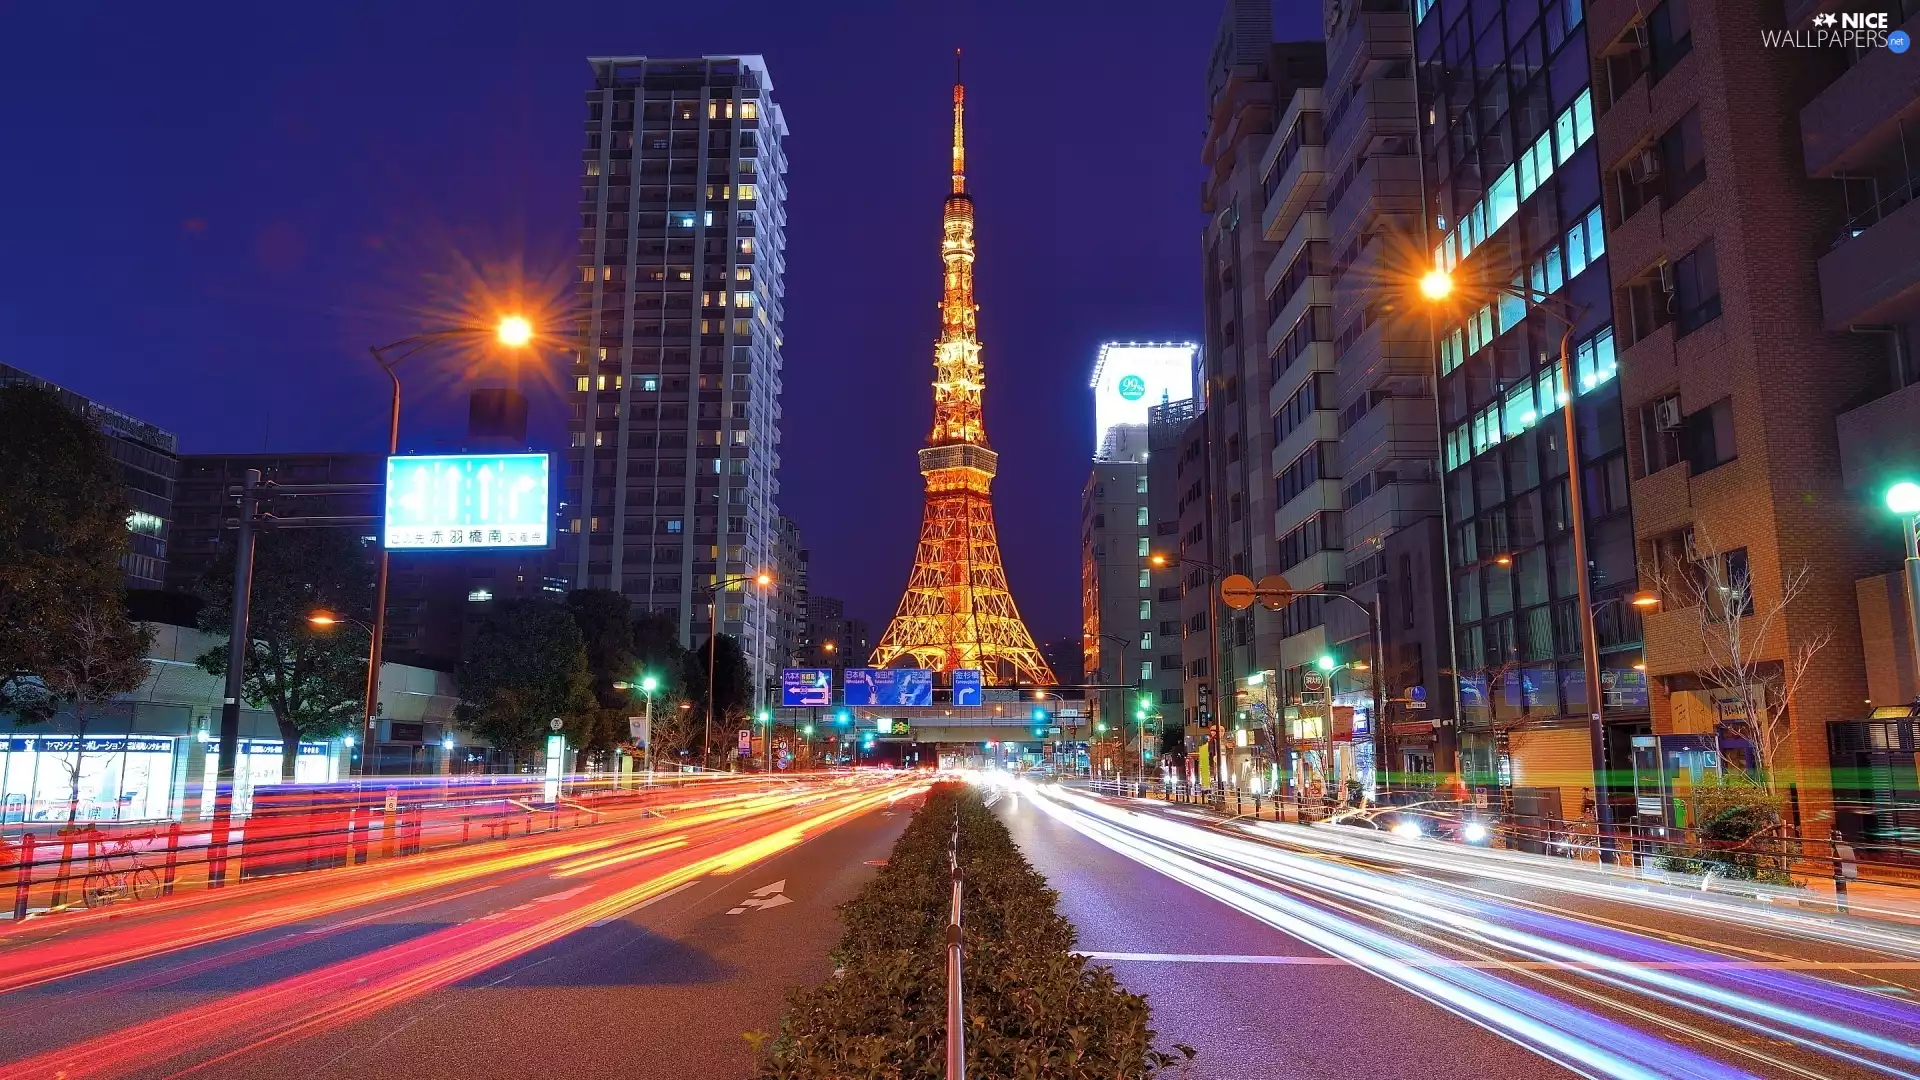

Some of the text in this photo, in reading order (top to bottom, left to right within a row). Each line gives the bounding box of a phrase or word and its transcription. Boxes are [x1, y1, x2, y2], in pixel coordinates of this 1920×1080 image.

[430, 530, 502, 544] 赤羽橋南
[785, 672, 800, 681] 六本木
[846, 671, 865, 679] 日本橋
[955, 671, 979, 680] 金杉橋
[740, 731, 749, 741] P
